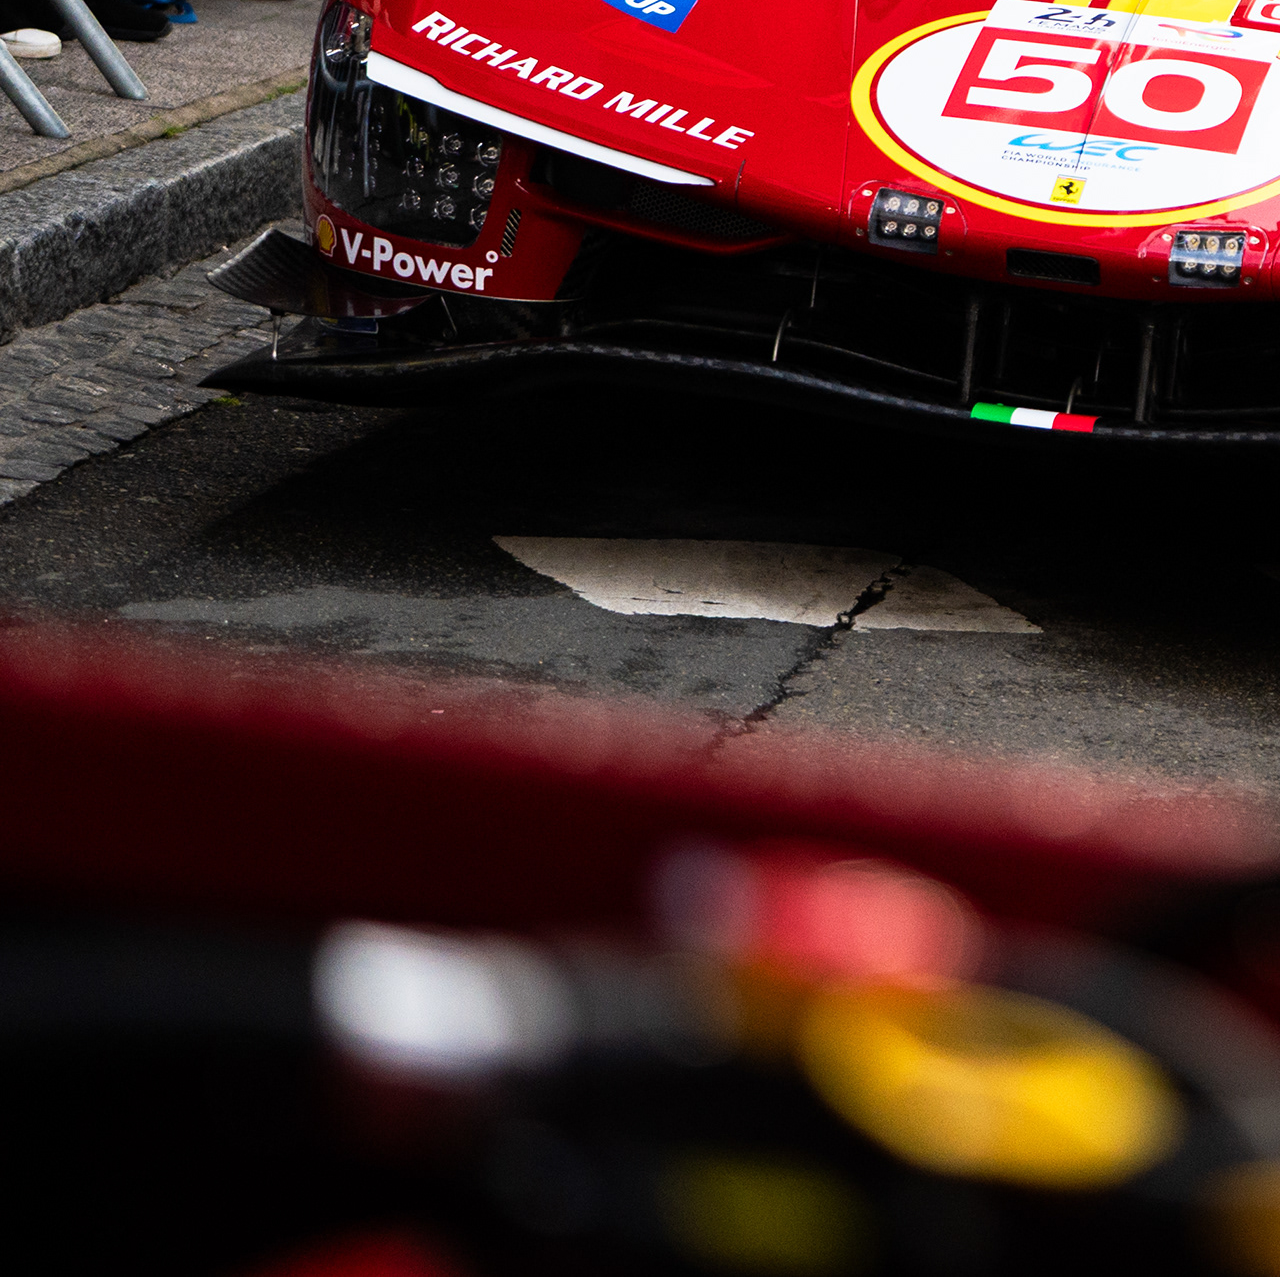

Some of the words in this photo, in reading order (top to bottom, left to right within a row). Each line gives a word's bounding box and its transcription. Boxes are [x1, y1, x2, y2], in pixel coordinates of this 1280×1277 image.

[412, 10, 605, 102] RICHARD
[603, 89, 755, 150] MILLE
[965, 37, 1243, 133] 50
[1001, 155, 1091, 171] CHAMPIONSHIP
[1008, 133, 1159, 161] WEC
[1026, 153, 1067, 163] WORLD
[1070, 159, 1142, 172] ENDURANCE
[340, 228, 493, 291] V-Power
